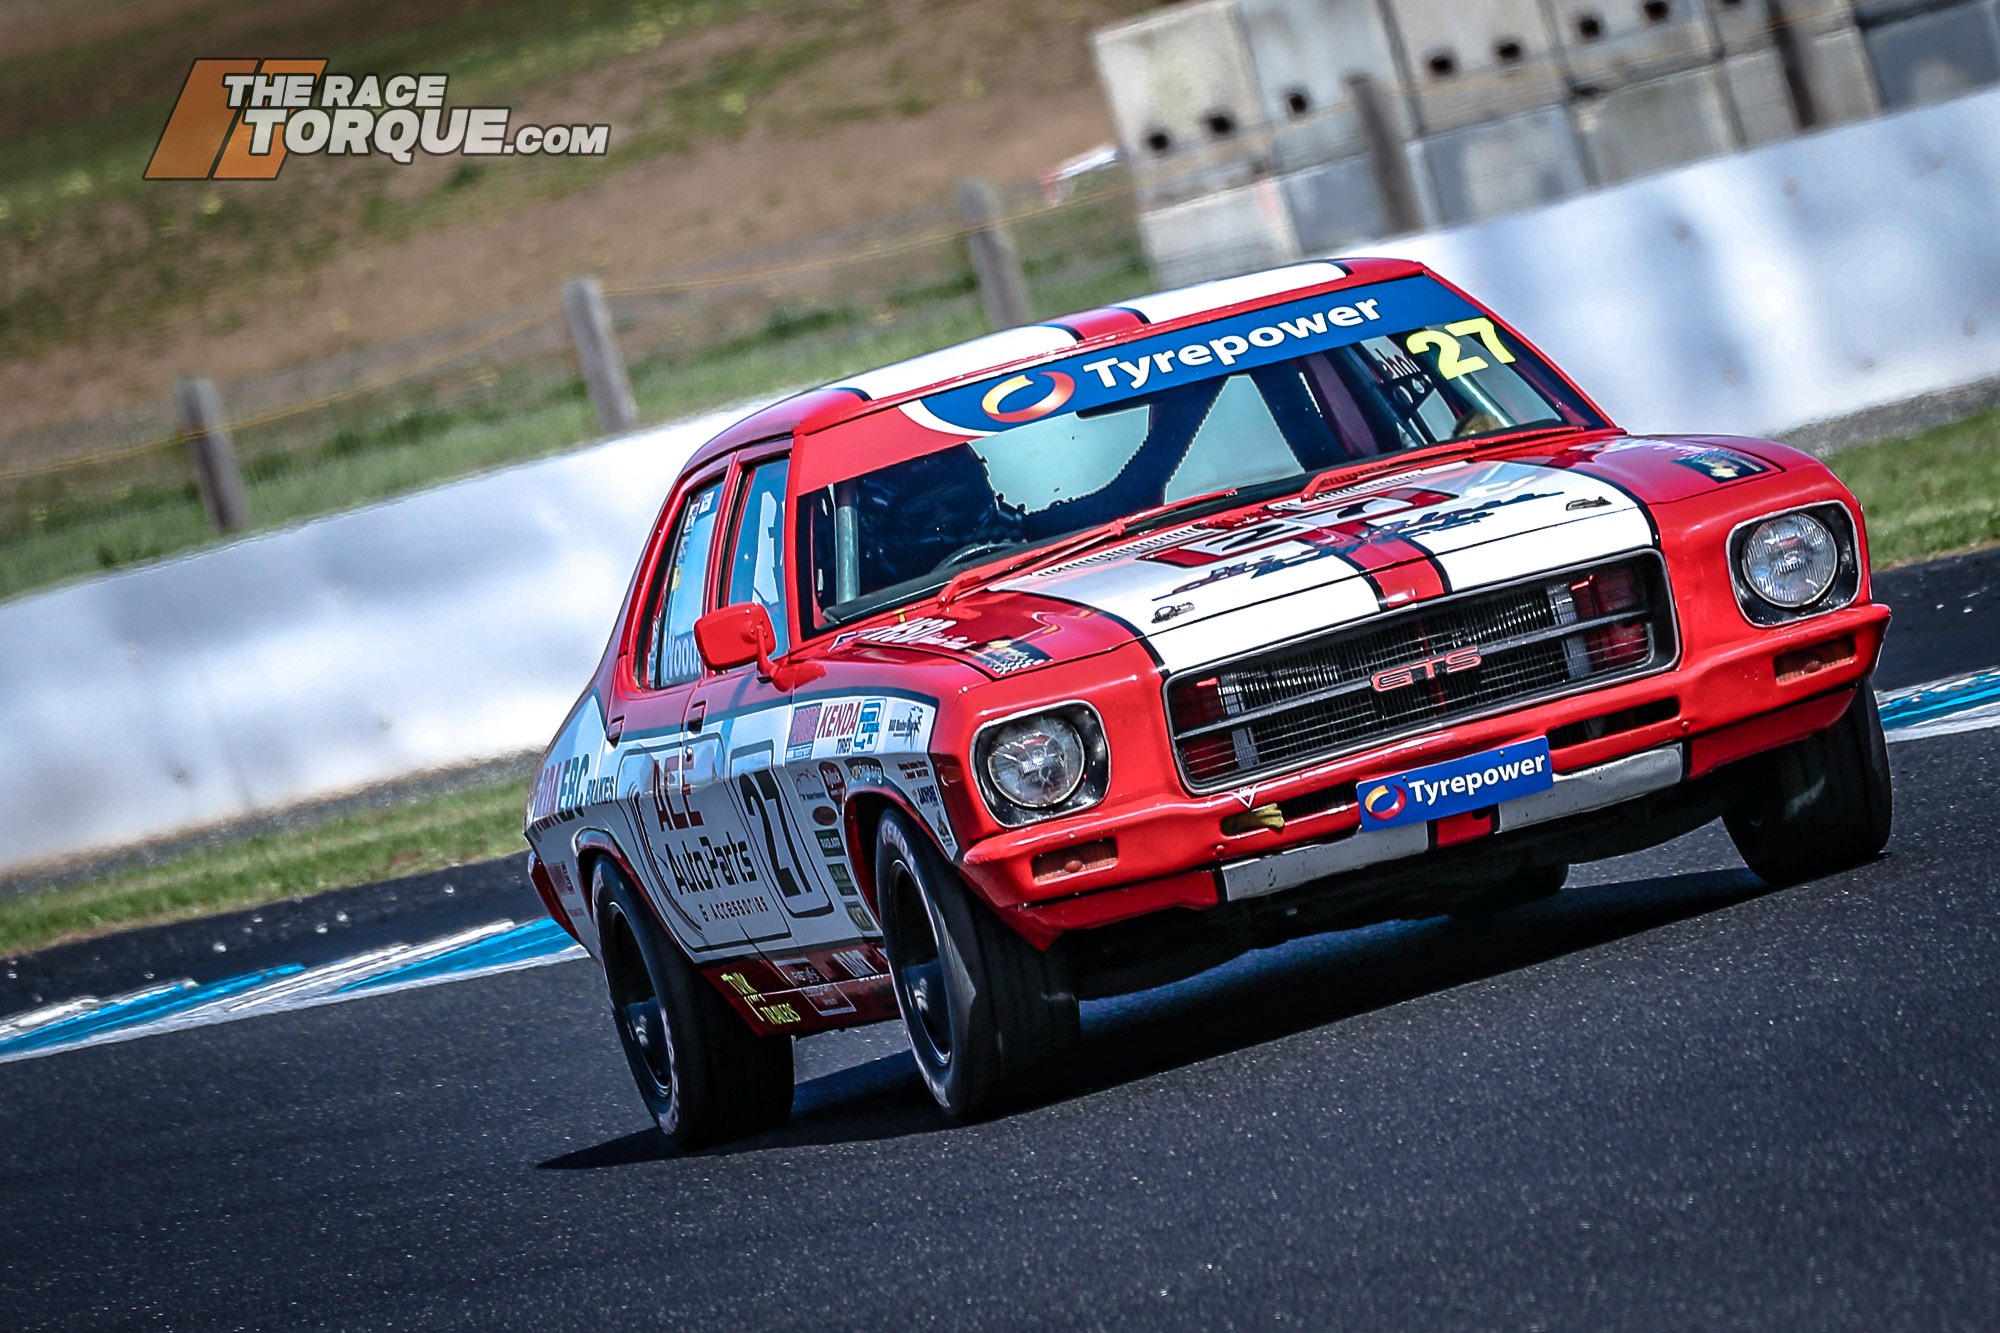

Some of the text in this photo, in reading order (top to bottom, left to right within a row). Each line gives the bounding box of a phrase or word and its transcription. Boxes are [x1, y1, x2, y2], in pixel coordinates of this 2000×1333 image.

[1081, 297, 1382, 391] Tyrepower
[1405, 316, 1517, 381] 27
[1203, 496, 1382, 553] 27
[1371, 645, 1482, 692] GTS
[816, 701, 862, 739] KENDA
[557, 753, 590, 822] EBC
[652, 753, 705, 832] ACE
[1407, 753, 1546, 806] Tyrepower
[738, 768, 814, 898] 27
